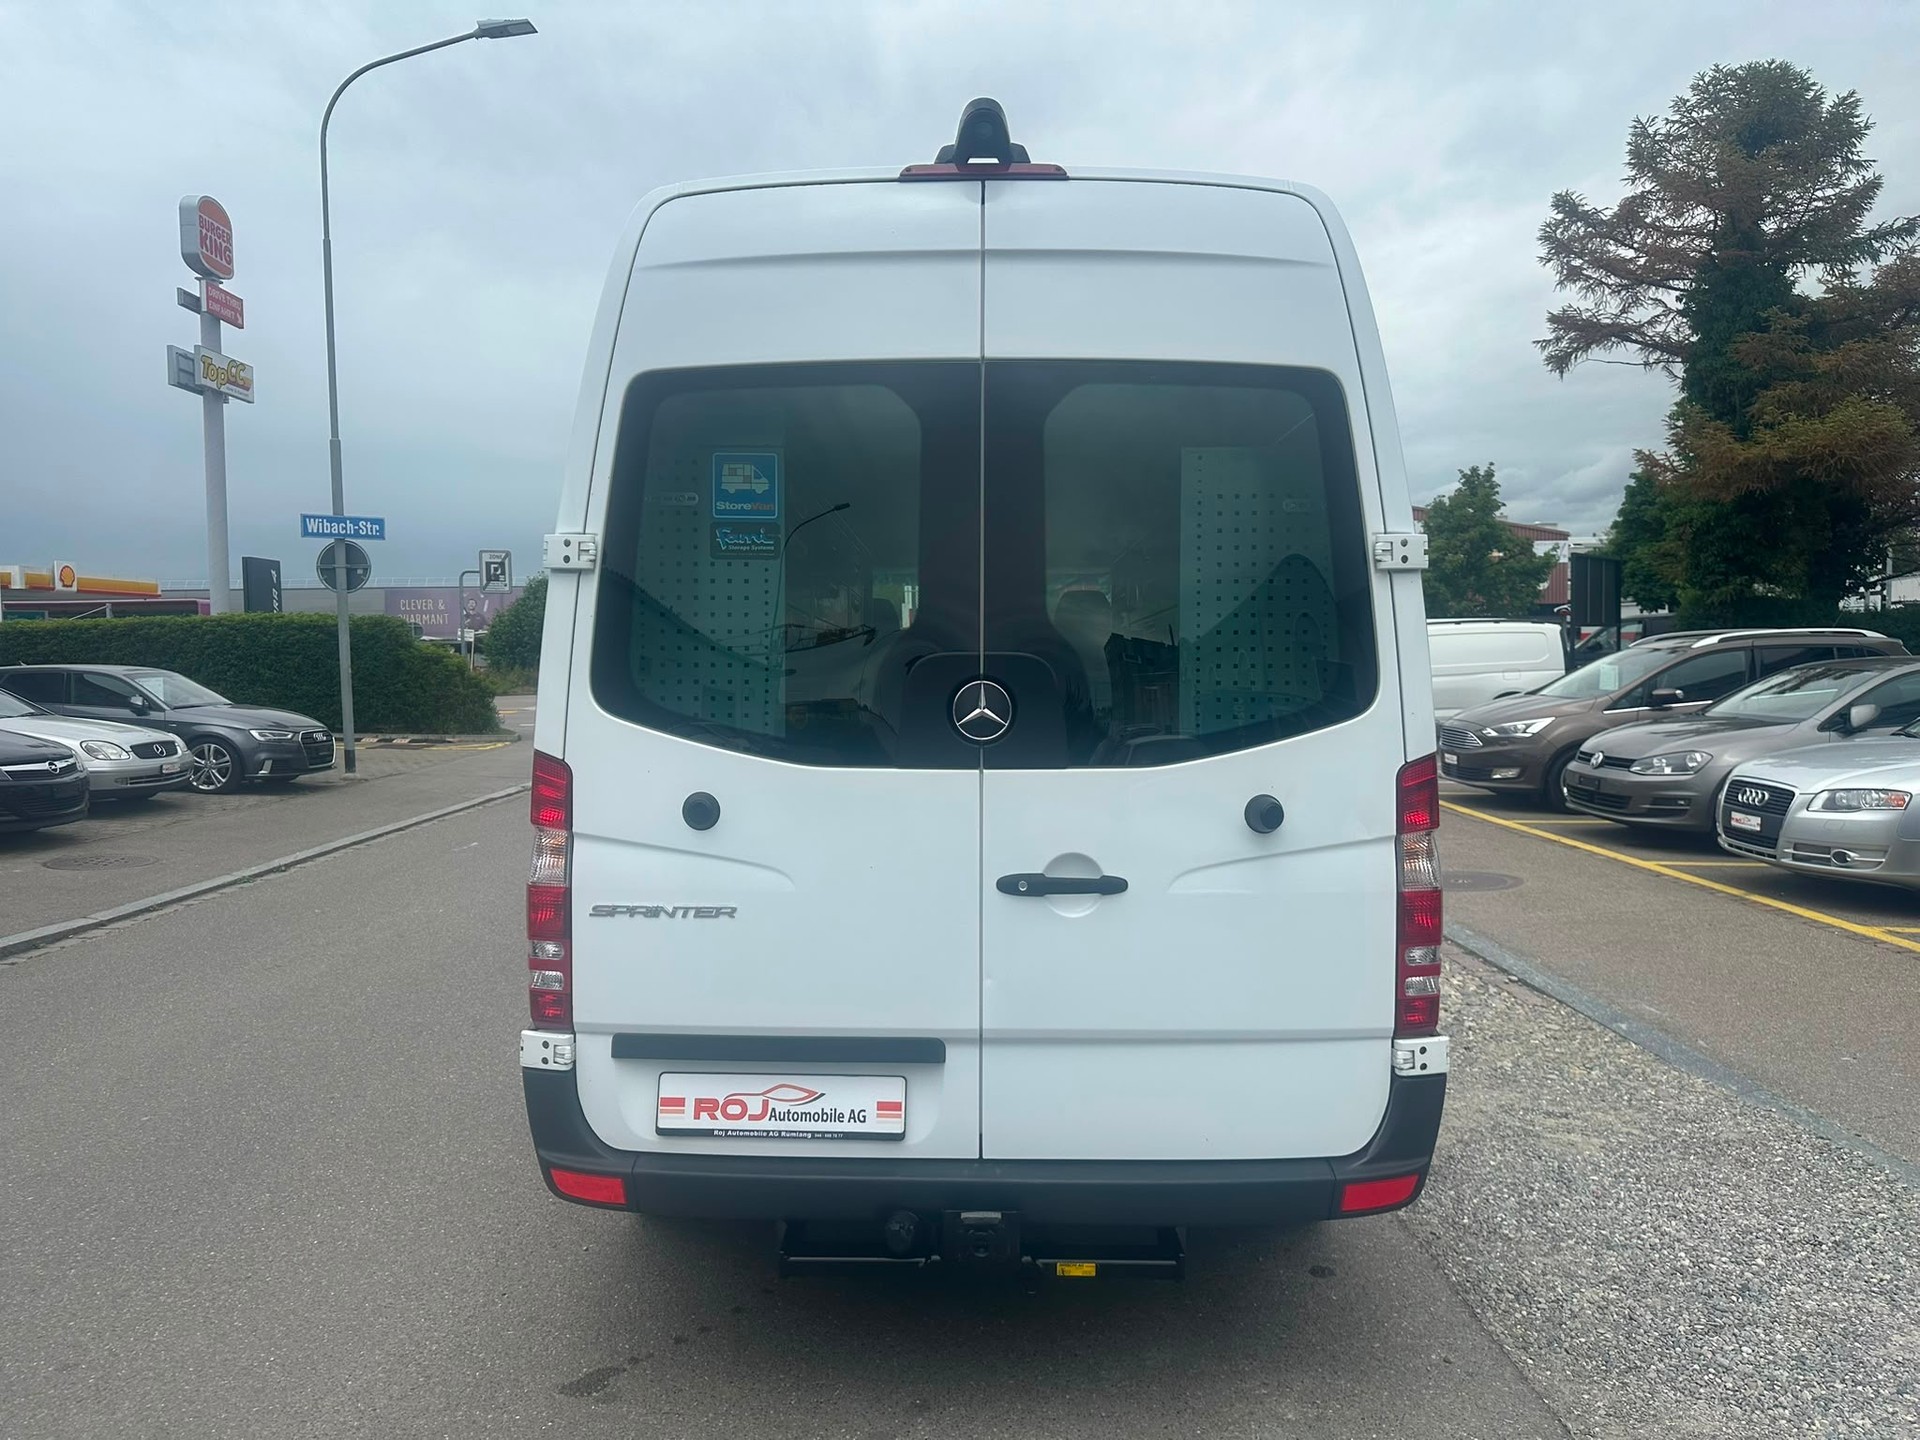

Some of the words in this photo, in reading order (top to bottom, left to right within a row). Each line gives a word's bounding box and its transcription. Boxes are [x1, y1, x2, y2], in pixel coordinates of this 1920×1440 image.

[198, 214, 232, 247] BURGER
[199, 229, 232, 266] KING
[201, 354, 247, 389] TopCC
[715, 501, 775, 511] StoreVan
[306, 518, 380, 535] Wibach-Str.
[400, 599, 434, 611] CLEVER
[438, 599, 446, 610] &
[589, 904, 738, 918] SPRINTER
[693, 1097, 769, 1121] ROJ
[768, 1107, 845, 1123] Automobile
[847, 1109, 867, 1123] AG
